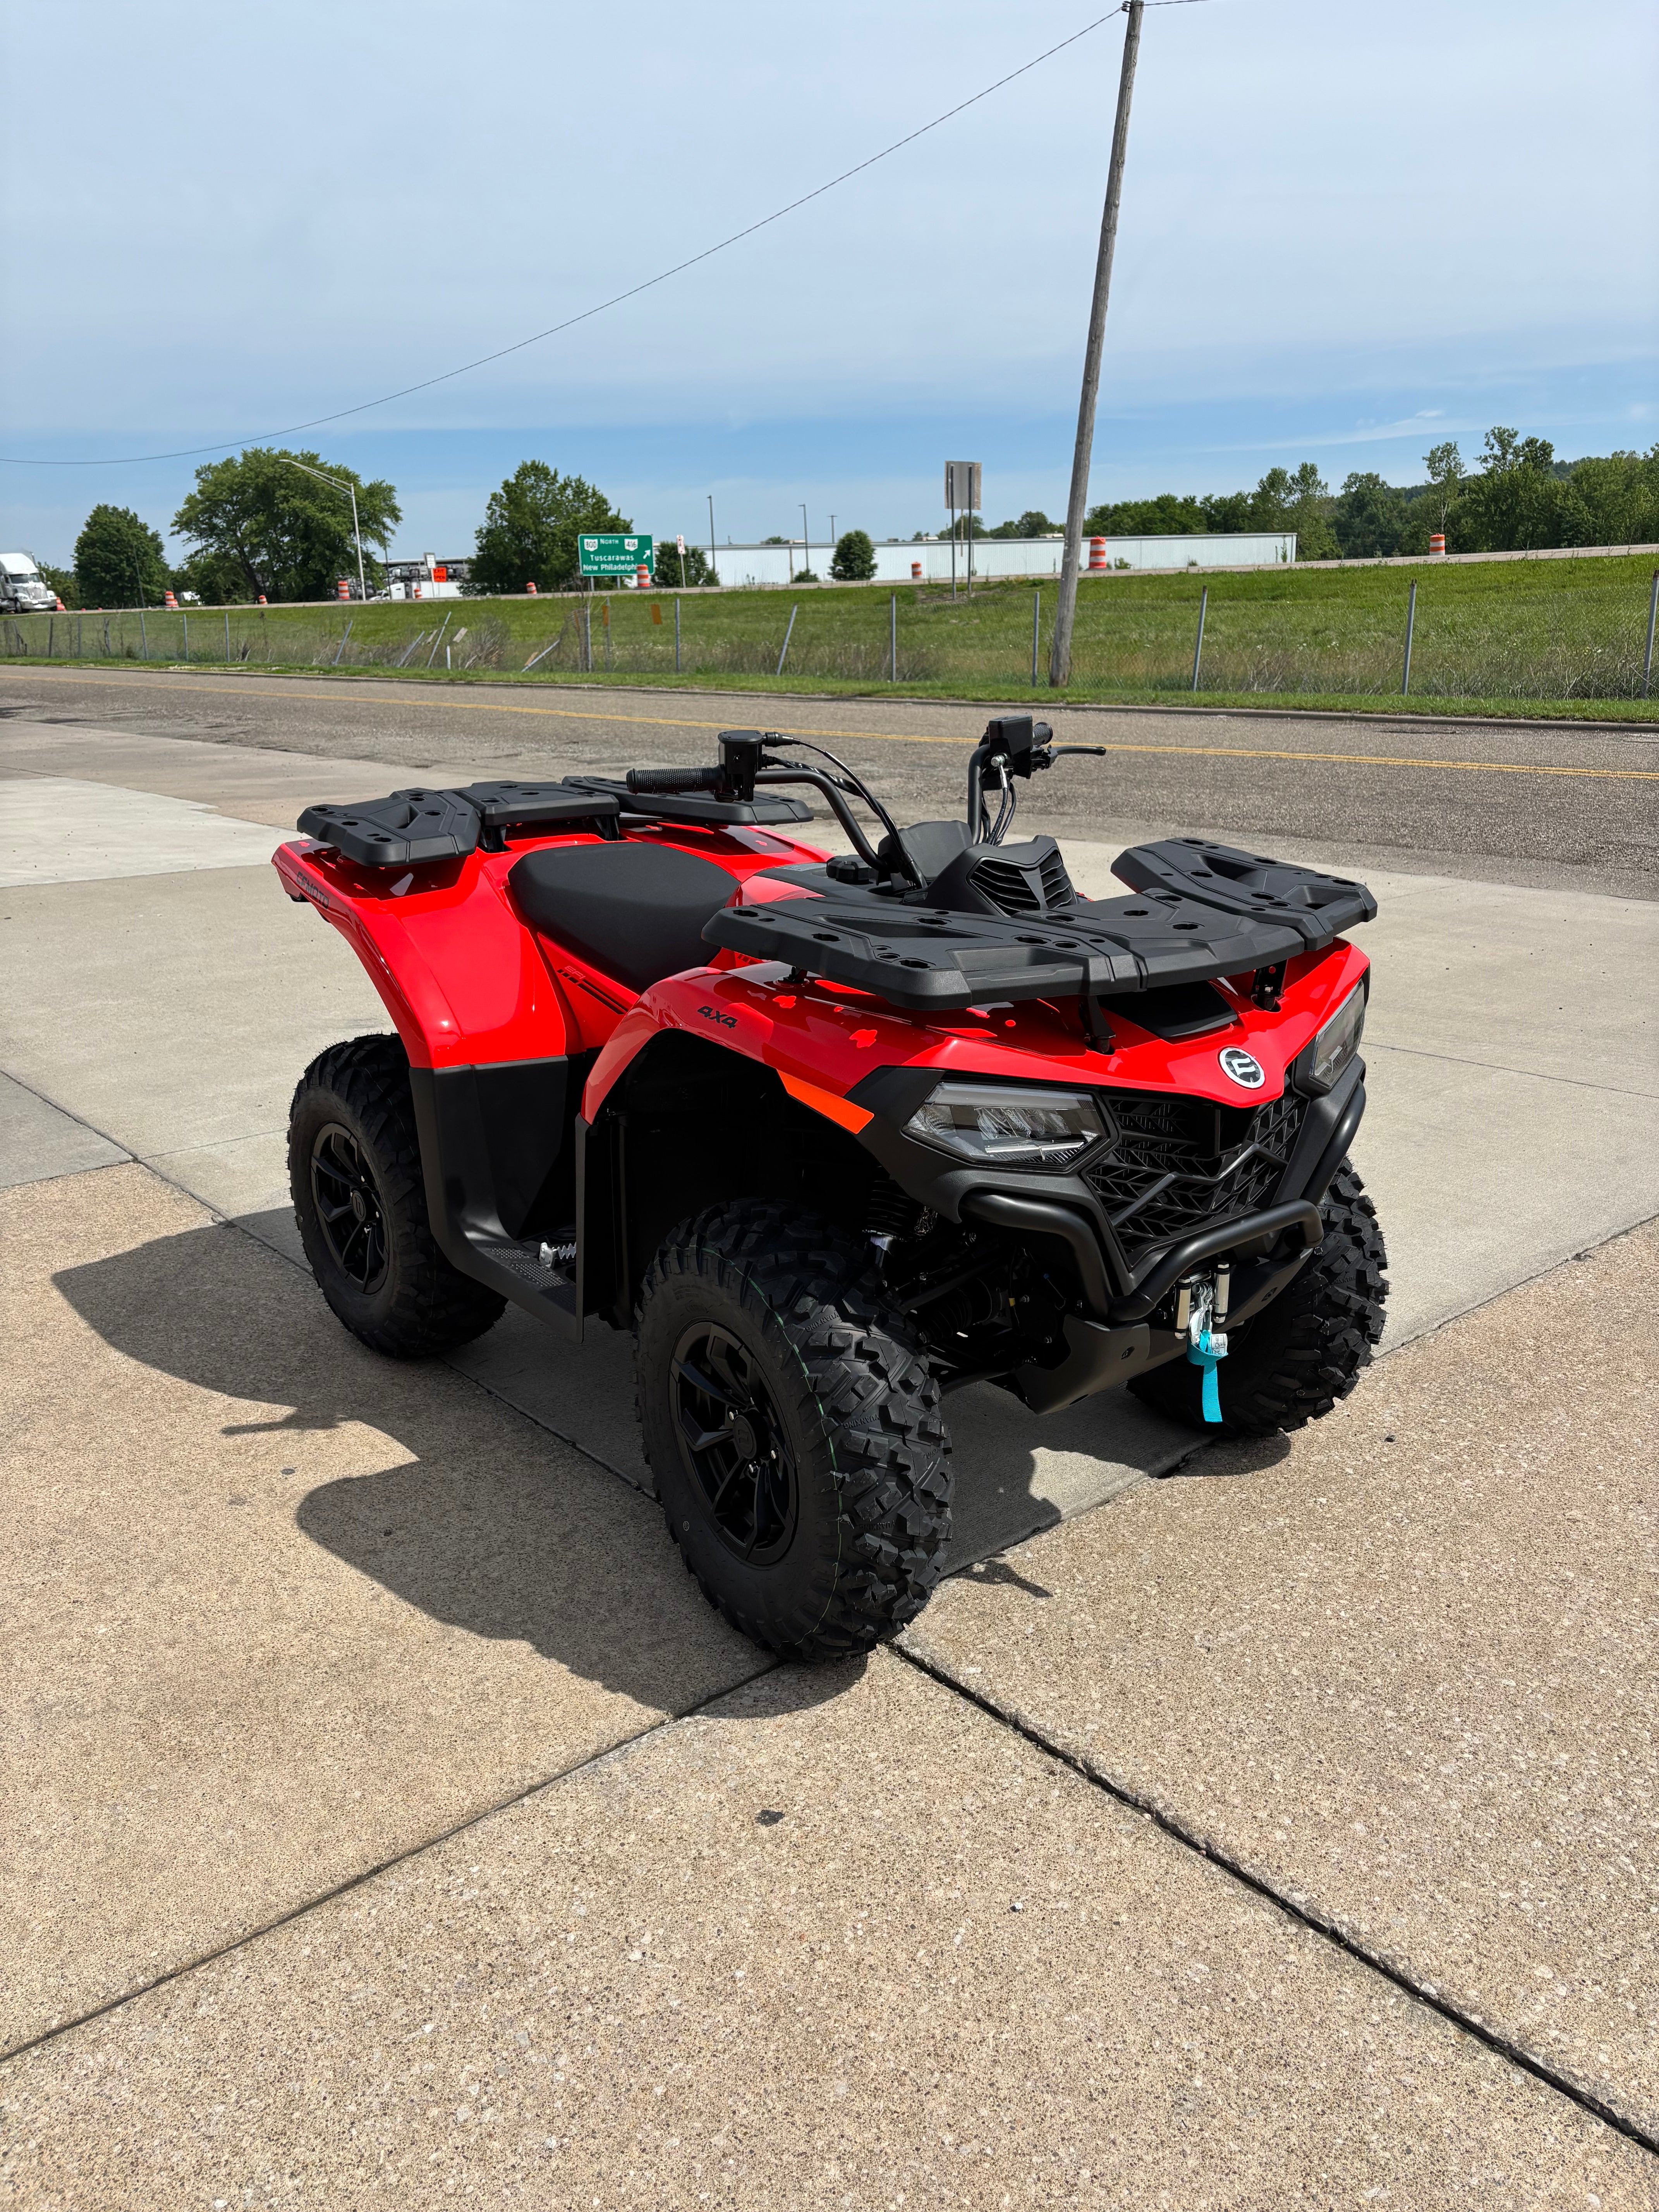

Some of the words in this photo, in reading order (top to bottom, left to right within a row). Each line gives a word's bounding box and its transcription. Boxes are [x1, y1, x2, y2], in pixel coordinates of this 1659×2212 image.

[601, 563, 638, 572] Philadelphi
[297, 871, 329, 909] CFMOTO
[565, 965, 586, 979] EFI
[697, 1006, 738, 1029] 4X4
